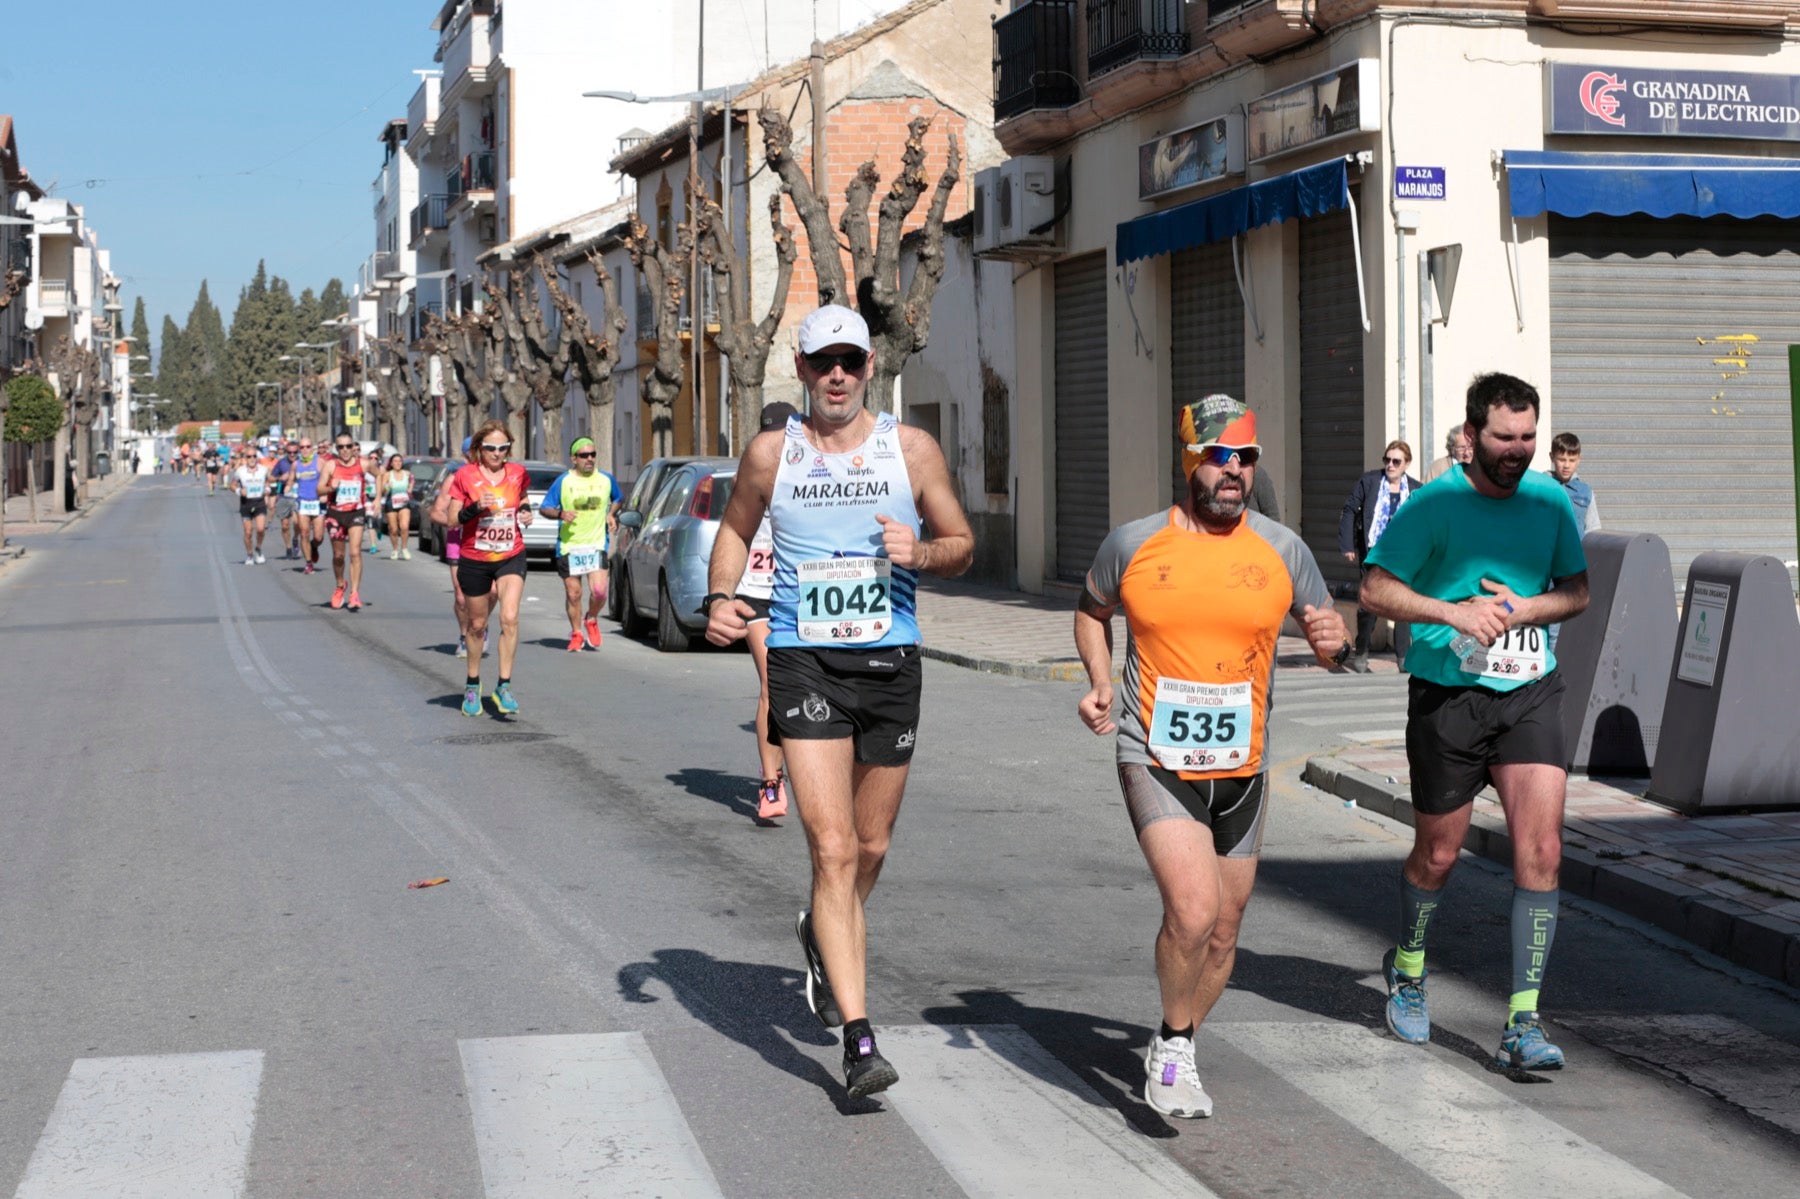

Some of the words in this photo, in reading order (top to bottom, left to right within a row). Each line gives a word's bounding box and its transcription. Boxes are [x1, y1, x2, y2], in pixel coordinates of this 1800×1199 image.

[1632, 81, 1751, 102] GRANADINA
[1649, 101, 1677, 119] DE
[1681, 103, 1800, 124] ELECTRICID
[1405, 168, 1433, 179] PLAZA
[1397, 182, 1444, 198] NARANJOS
[792, 481, 890, 500] MARACENA
[836, 499, 879, 507] ATLETISMO
[478, 526, 513, 541] 2026
[818, 562, 836, 571] GRAN
[836, 561, 857, 570] PREMIO
[858, 560, 865, 568] DE
[866, 559, 886, 568] FONDO
[826, 569, 862, 580] DIPUTACIÓN
[806, 582, 887, 617] 1042
[1488, 625, 1539, 653] 110
[1179, 684, 1196, 694] GRAN
[1196, 686, 1220, 696] PREMIO
[1220, 686, 1229, 696] DE
[1229, 685, 1246, 696] FONDO
[1186, 695, 1224, 706] DIPUTACIÓN
[1168, 709, 1237, 743] 535
[1526, 907, 1554, 983] kalenji
